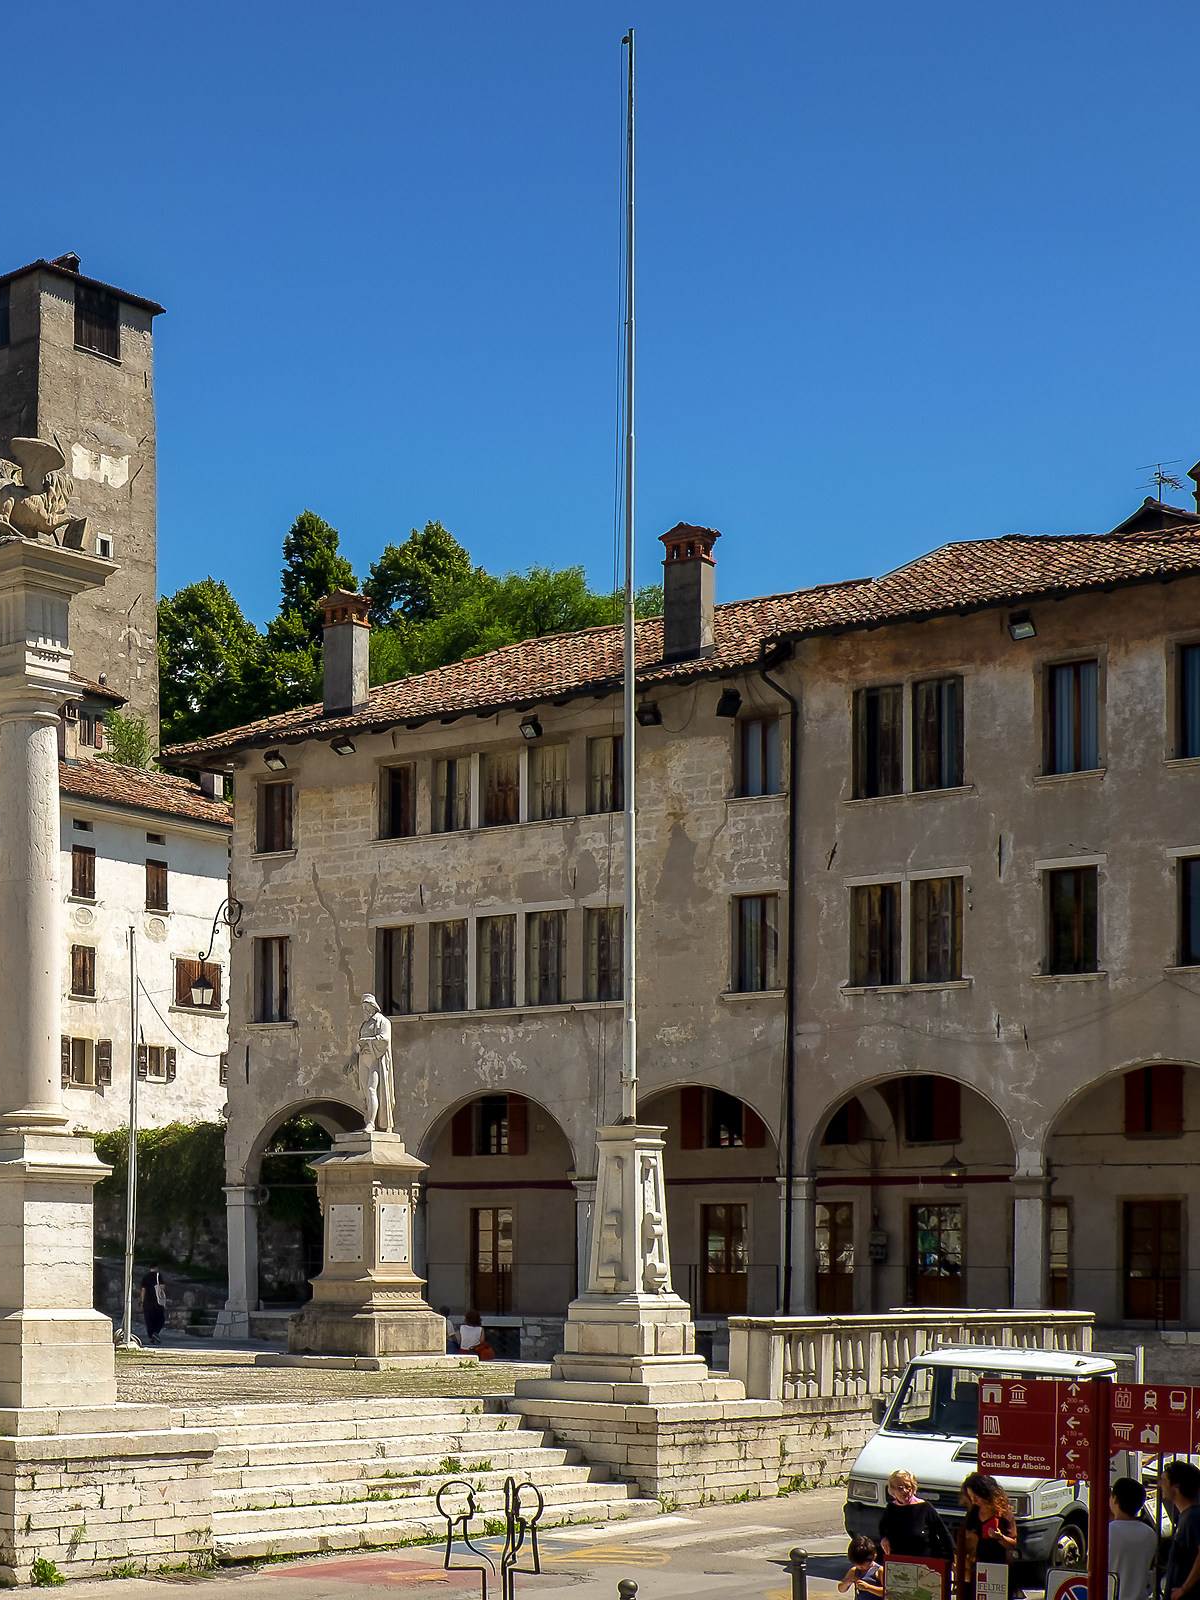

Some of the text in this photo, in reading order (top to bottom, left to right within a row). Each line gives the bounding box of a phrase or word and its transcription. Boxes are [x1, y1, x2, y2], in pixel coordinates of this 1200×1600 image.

[981, 1452, 1006, 1460] Chiesa
[1023, 1454, 1045, 1462] Rocco
[981, 1460, 1010, 1469] Castello
[1021, 1462, 1051, 1471] Alboino
